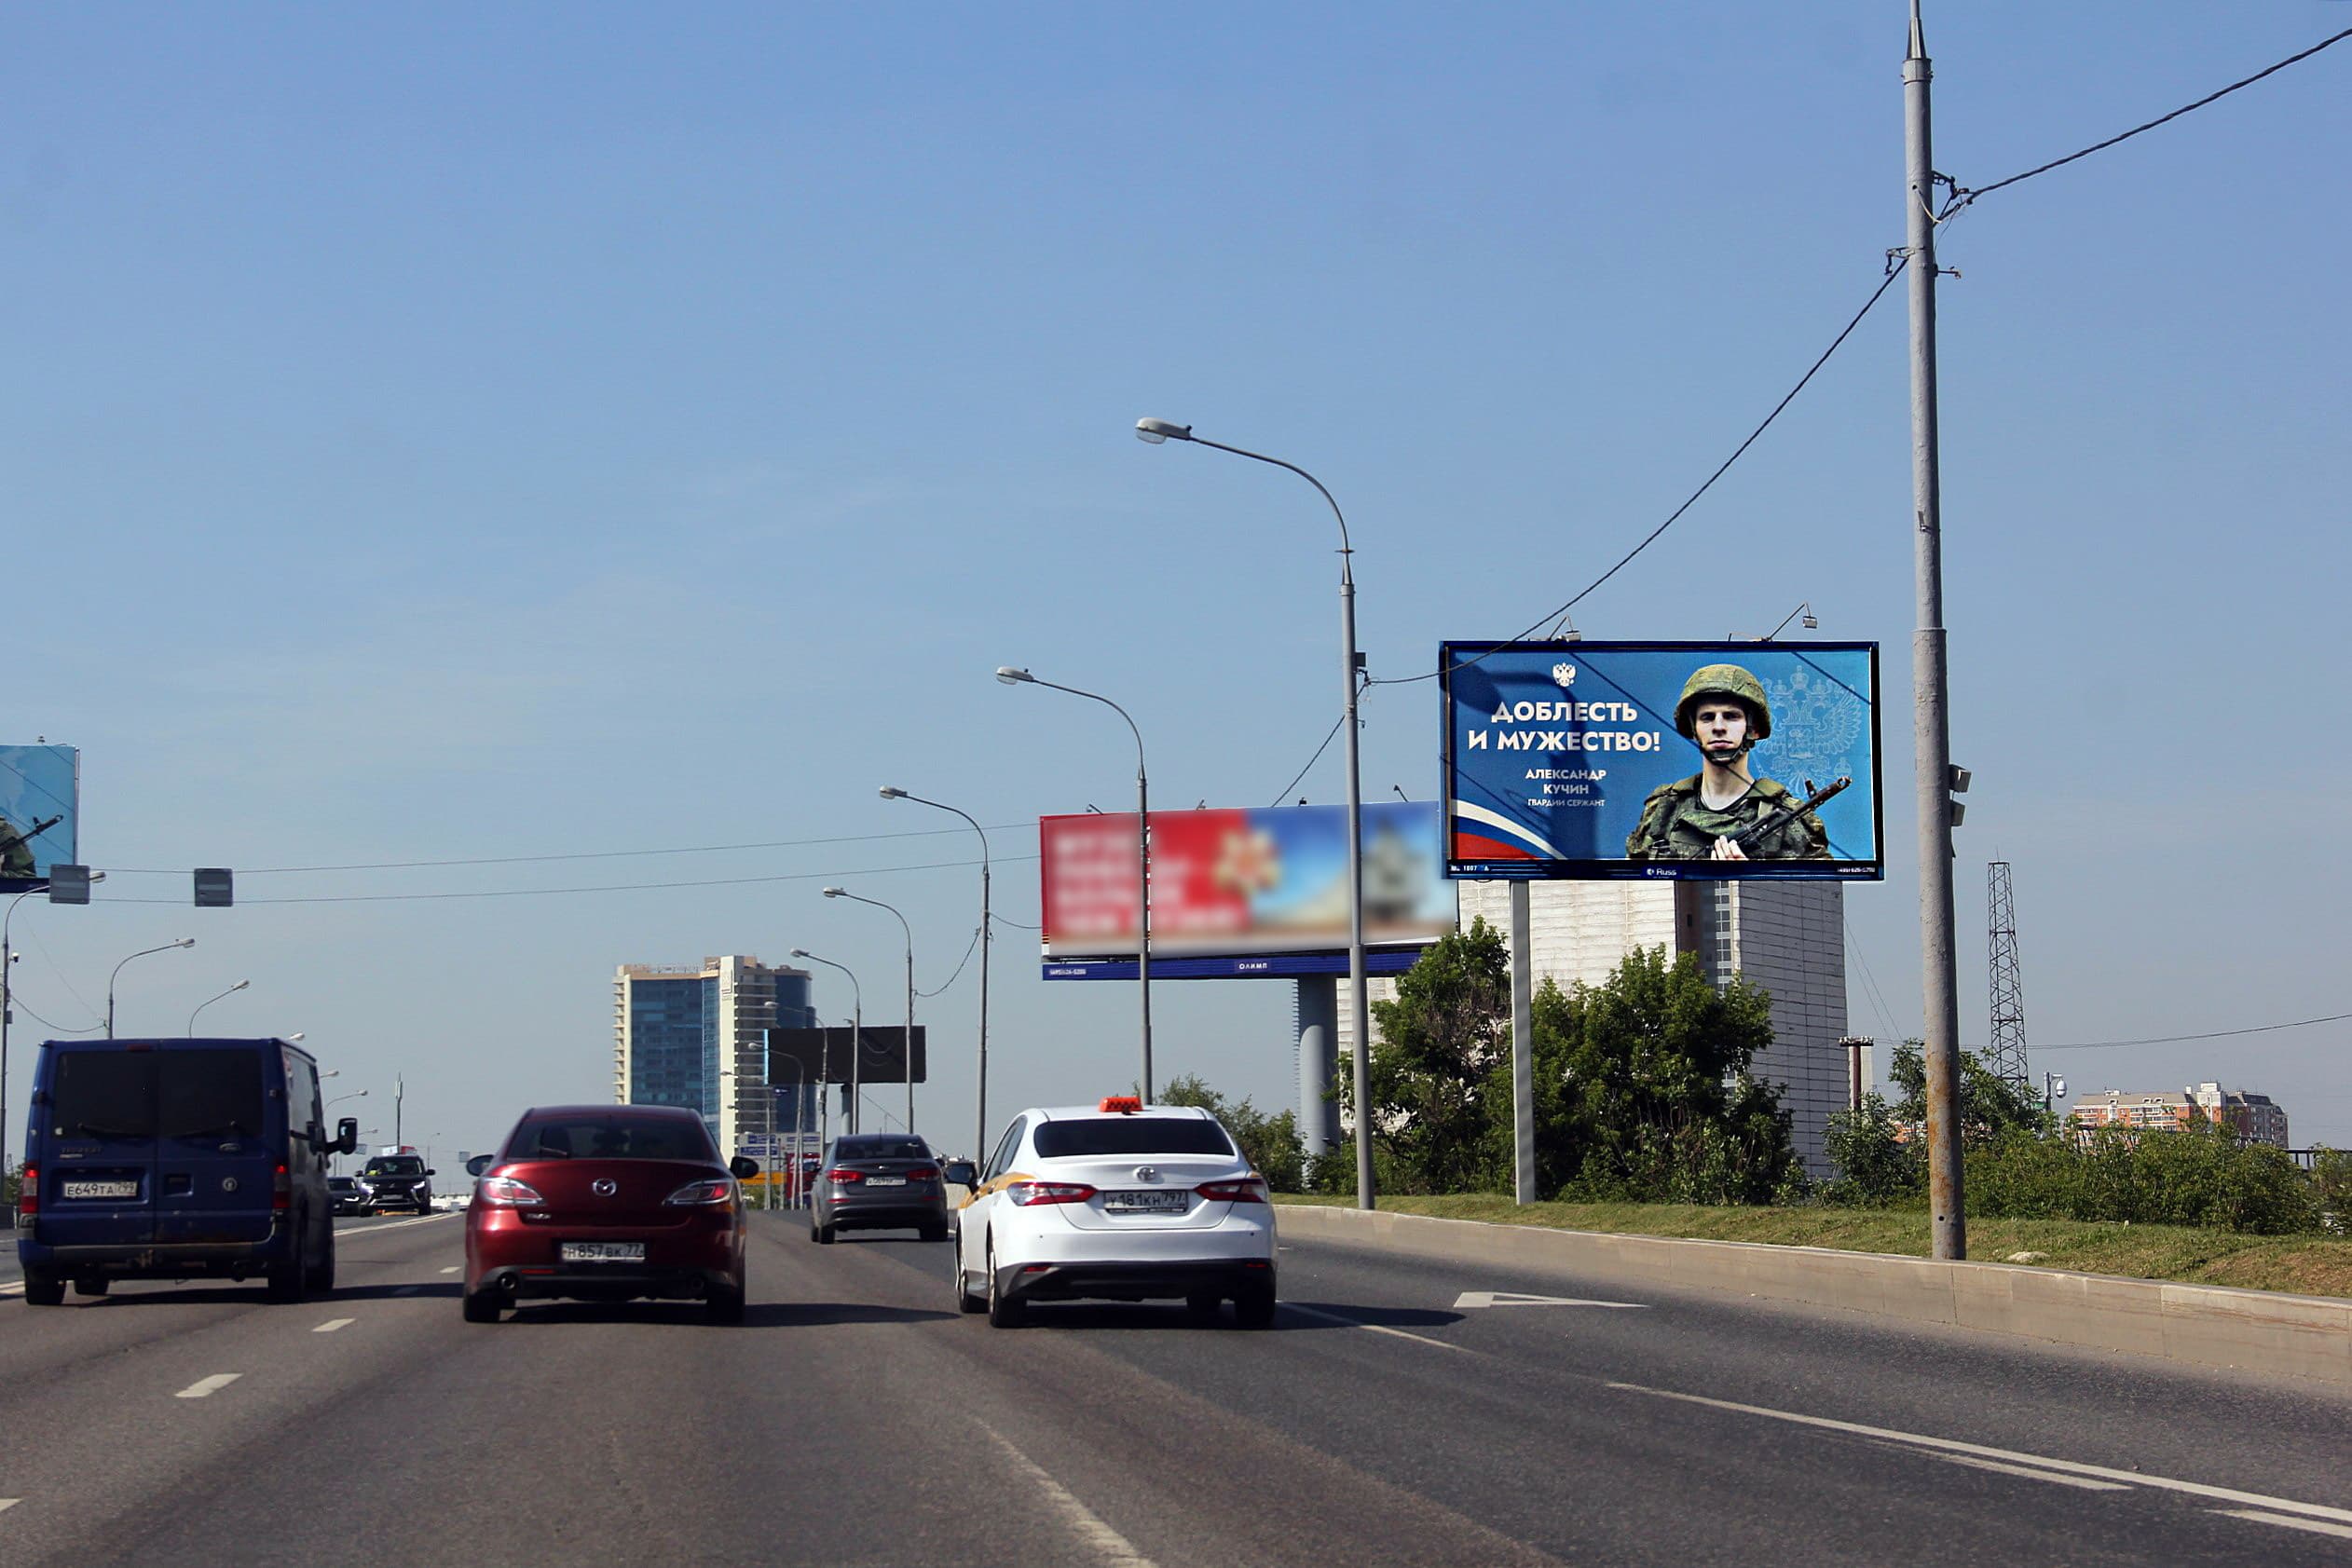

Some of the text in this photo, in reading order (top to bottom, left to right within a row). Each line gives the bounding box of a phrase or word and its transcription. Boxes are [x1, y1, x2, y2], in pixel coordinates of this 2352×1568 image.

[1491, 701, 1638, 724] ДОБЛЕСТЬ
[1468, 729, 1661, 752] И МУЖЕСТВО!
[1525, 769, 1607, 781] АЛЕКСАНДР
[1543, 784, 1589, 795] КУЧИН
[1527, 798, 1606, 807] ГВАРДИИ СЕРЖАНТ
[1656, 867, 1677, 876] Russ
